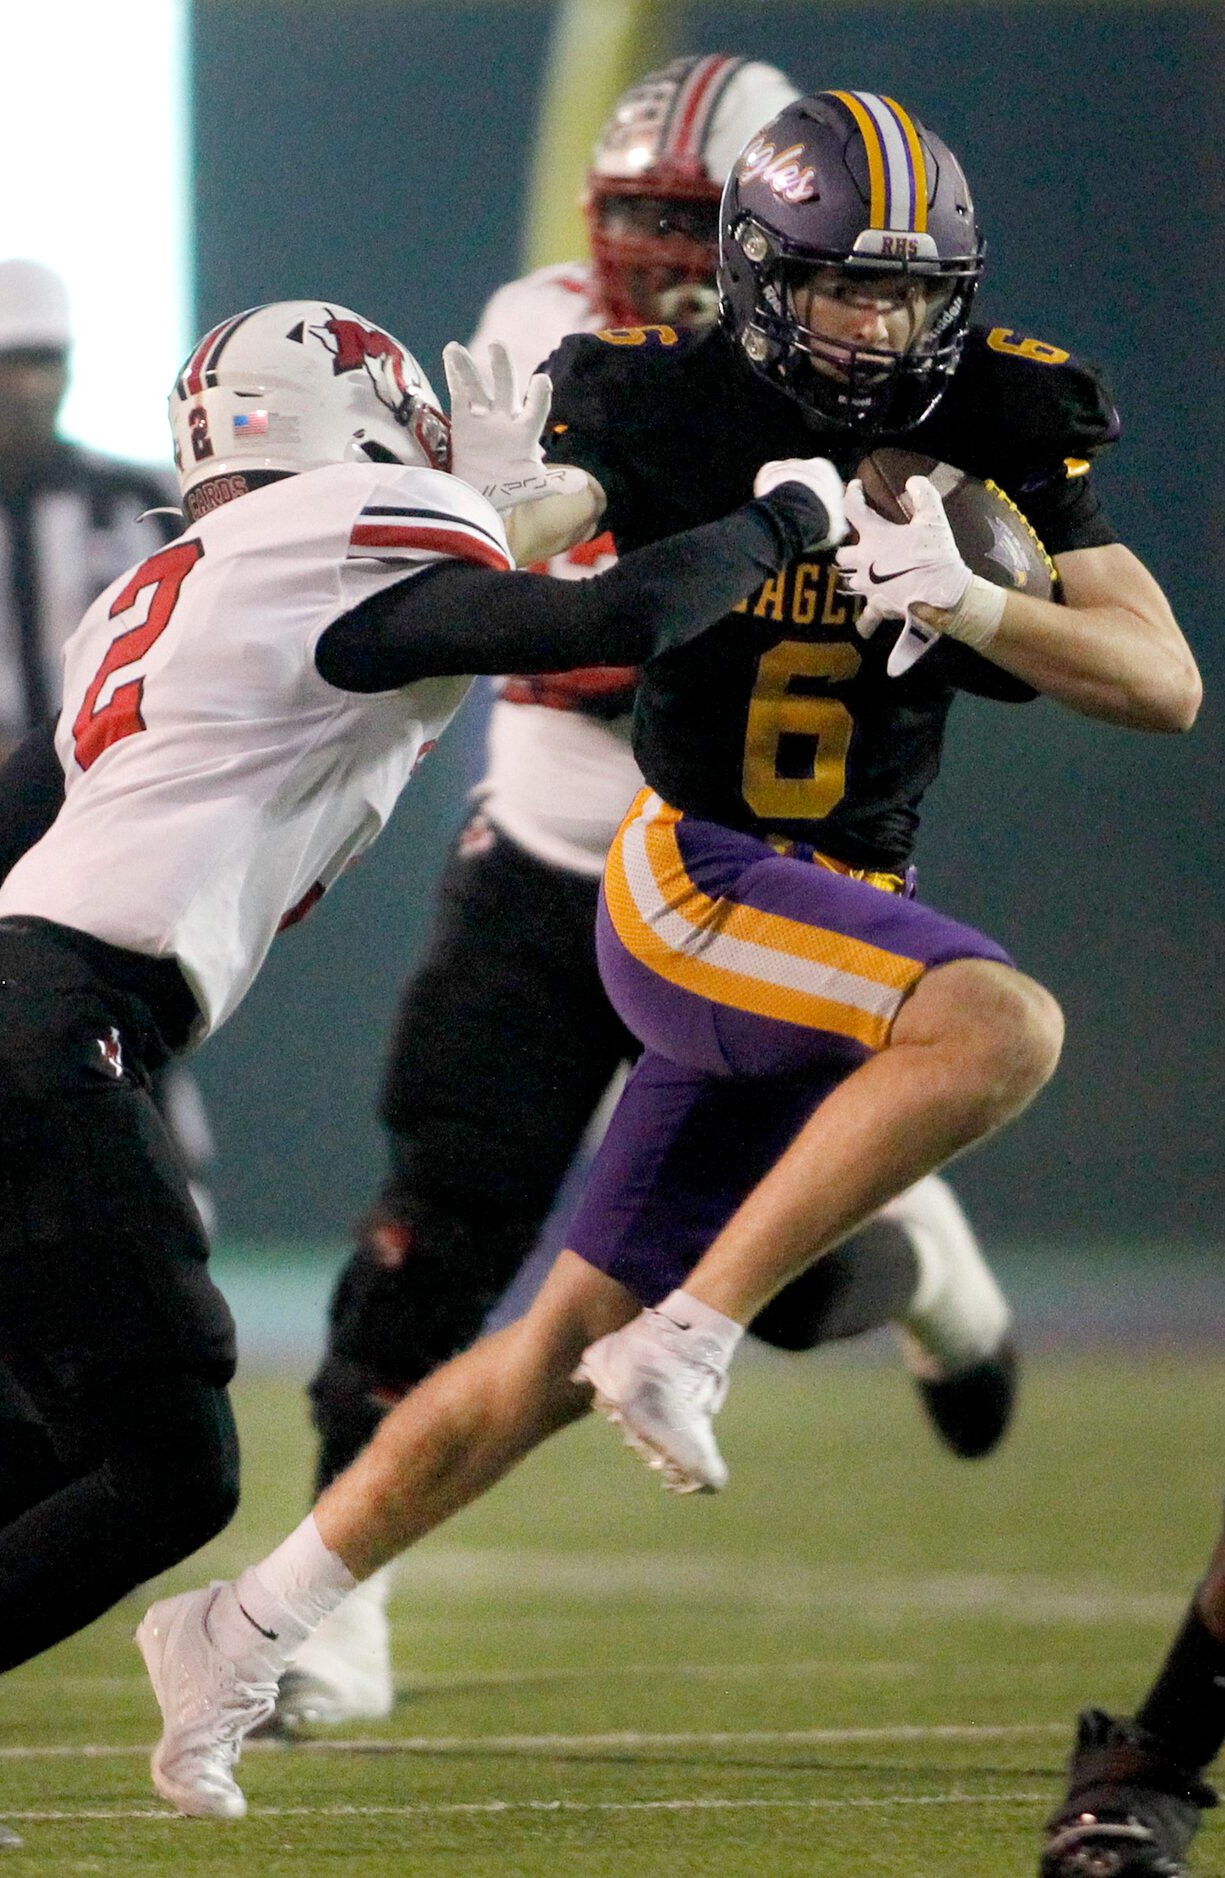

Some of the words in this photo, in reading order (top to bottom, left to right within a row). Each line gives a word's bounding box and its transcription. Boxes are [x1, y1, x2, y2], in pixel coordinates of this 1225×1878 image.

[881, 236, 920, 257] RHS
[596, 325, 679, 346] 6
[986, 327, 1071, 364] 6
[188, 404, 214, 462] 2
[187, 474, 249, 522] CARDS
[733, 562, 864, 625] AGL
[72, 536, 206, 773] 2
[741, 640, 863, 820] 6
